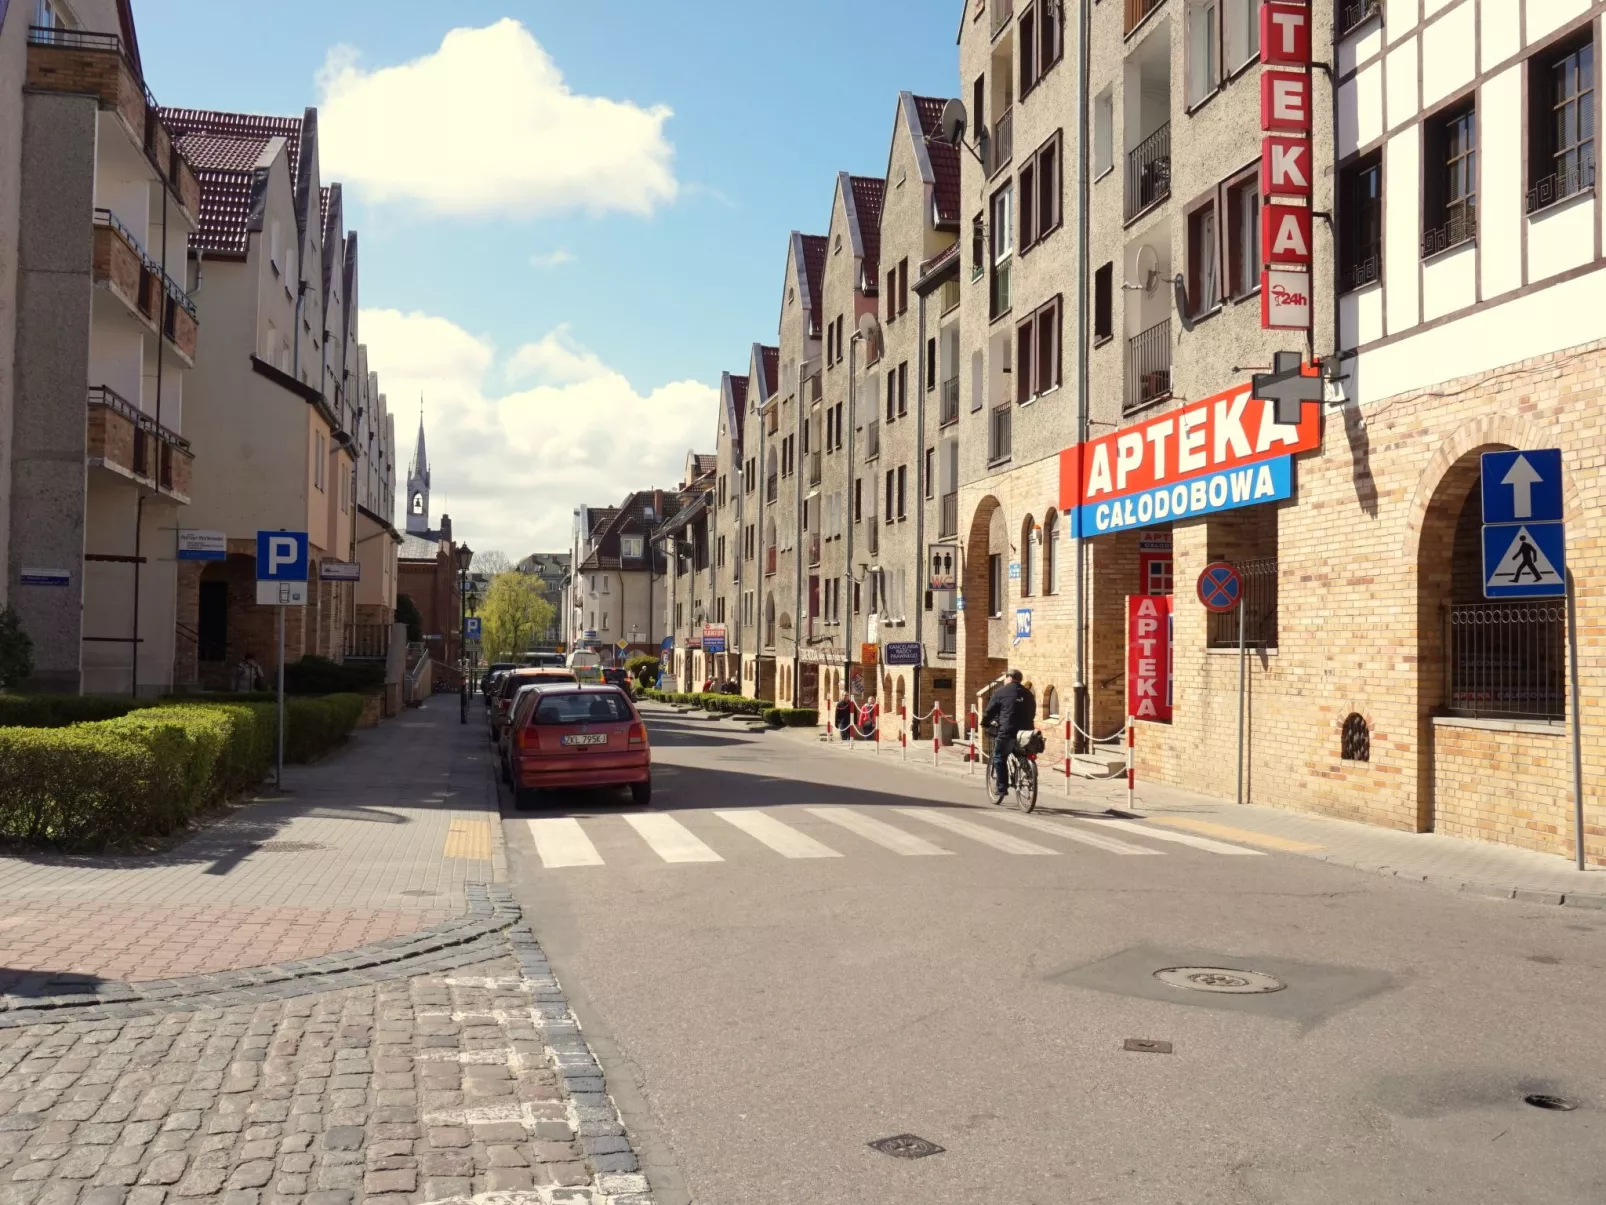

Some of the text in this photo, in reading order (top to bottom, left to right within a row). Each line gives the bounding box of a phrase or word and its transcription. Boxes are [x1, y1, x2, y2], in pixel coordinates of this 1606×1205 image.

[1281, 292, 1307, 306] 24h
[1095, 464, 1276, 531] CAŁODOBOWA
[268, 536, 298, 575] P
[931, 576, 953, 589] WC
[467, 619, 478, 632] P
[1017, 612, 1031, 634] WC
[1136, 598, 1158, 717] APTEKA
[565, 736, 580, 744] ZKL
